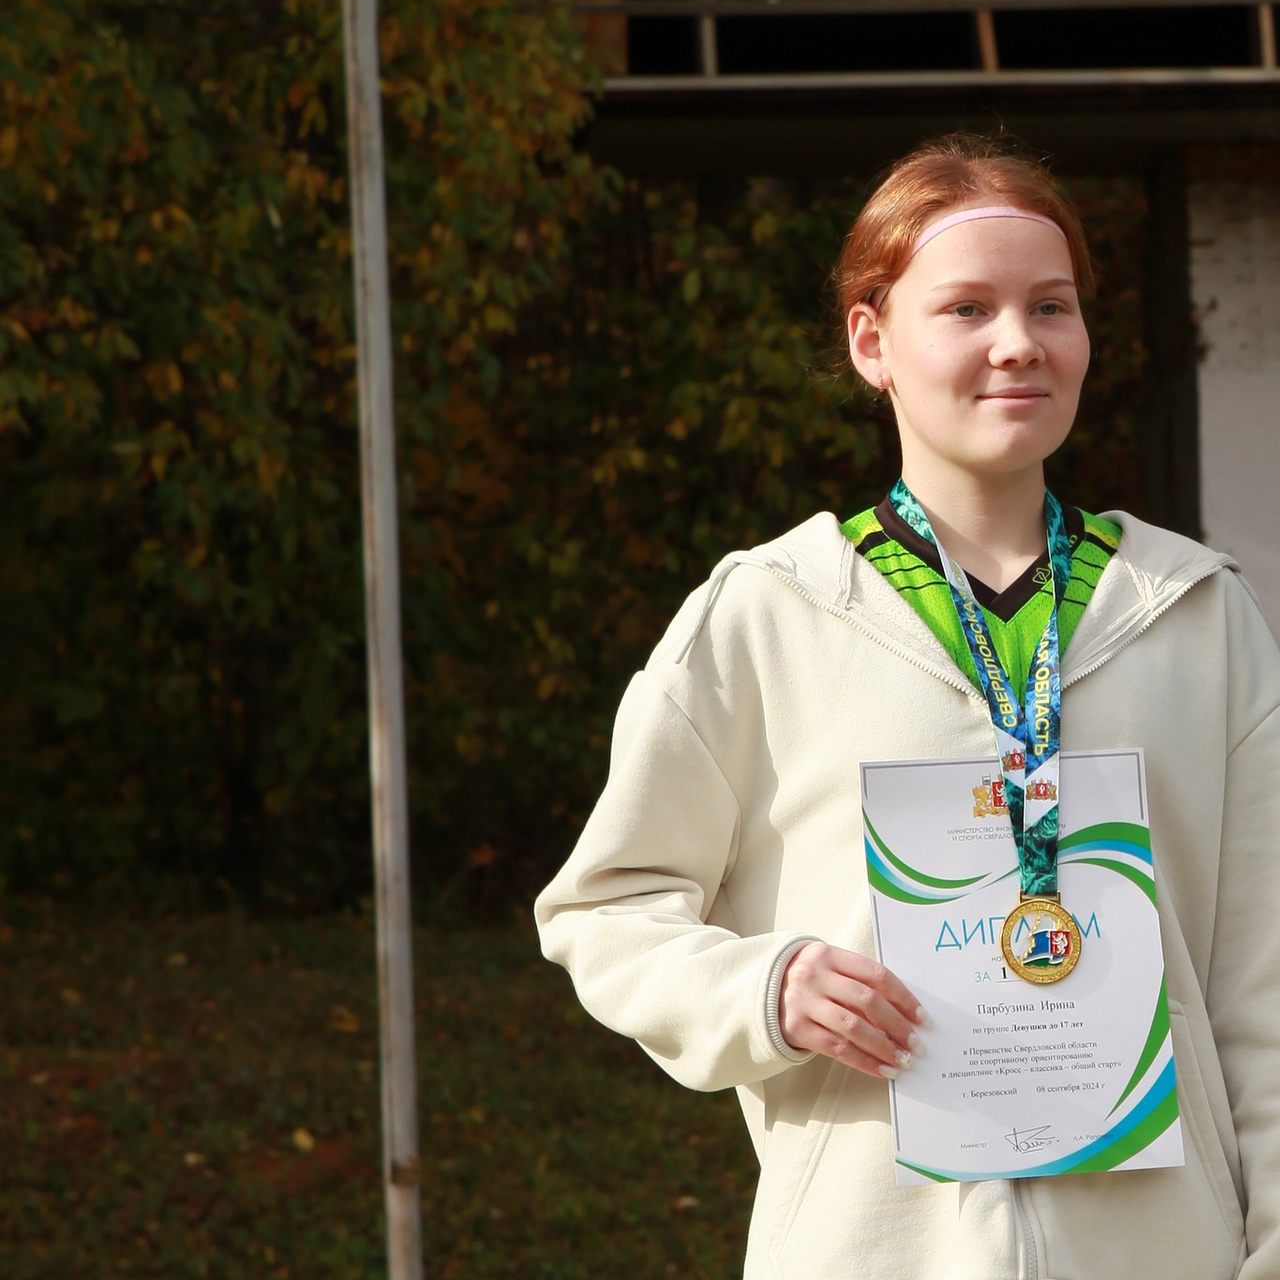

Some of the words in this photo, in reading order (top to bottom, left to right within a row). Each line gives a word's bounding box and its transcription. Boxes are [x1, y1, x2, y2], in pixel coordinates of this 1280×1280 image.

[1034, 666, 1050, 756] ОБЛАСТЬ
[935, 911, 1101, 952] ДИПЛМ
[974, 971, 992, 983] ЗА
[1000, 966, 1008, 980] 1
[977, 1000, 1036, 1017] Парбузина
[1040, 1000, 1075, 1013] Ирина
[984, 1025, 1010, 1035] группе
[1010, 1023, 1048, 1034] Девушки
[1049, 1023, 1059, 1031] до
[1060, 1021, 1069, 1029] 17
[1070, 1021, 1085, 1029] лет
[969, 1047, 1013, 1057] Первенстве
[1013, 1042, 1067, 1054] Свердловской
[1068, 1040, 1098, 1050] области
[980, 1056, 1029, 1067] спортивному
[1030, 1051, 1094, 1064] ориентированию
[948, 1068, 993, 1079] дисциплине
[1030, 1064, 1064, 1073] классика
[1070, 1061, 1096, 1071] общий
[970, 1087, 1018, 1099] Березовский
[1036, 1085, 1046, 1093] 08
[1047, 1083, 1081, 1094] сентября
[1082, 1081, 1100, 1090] 2024
